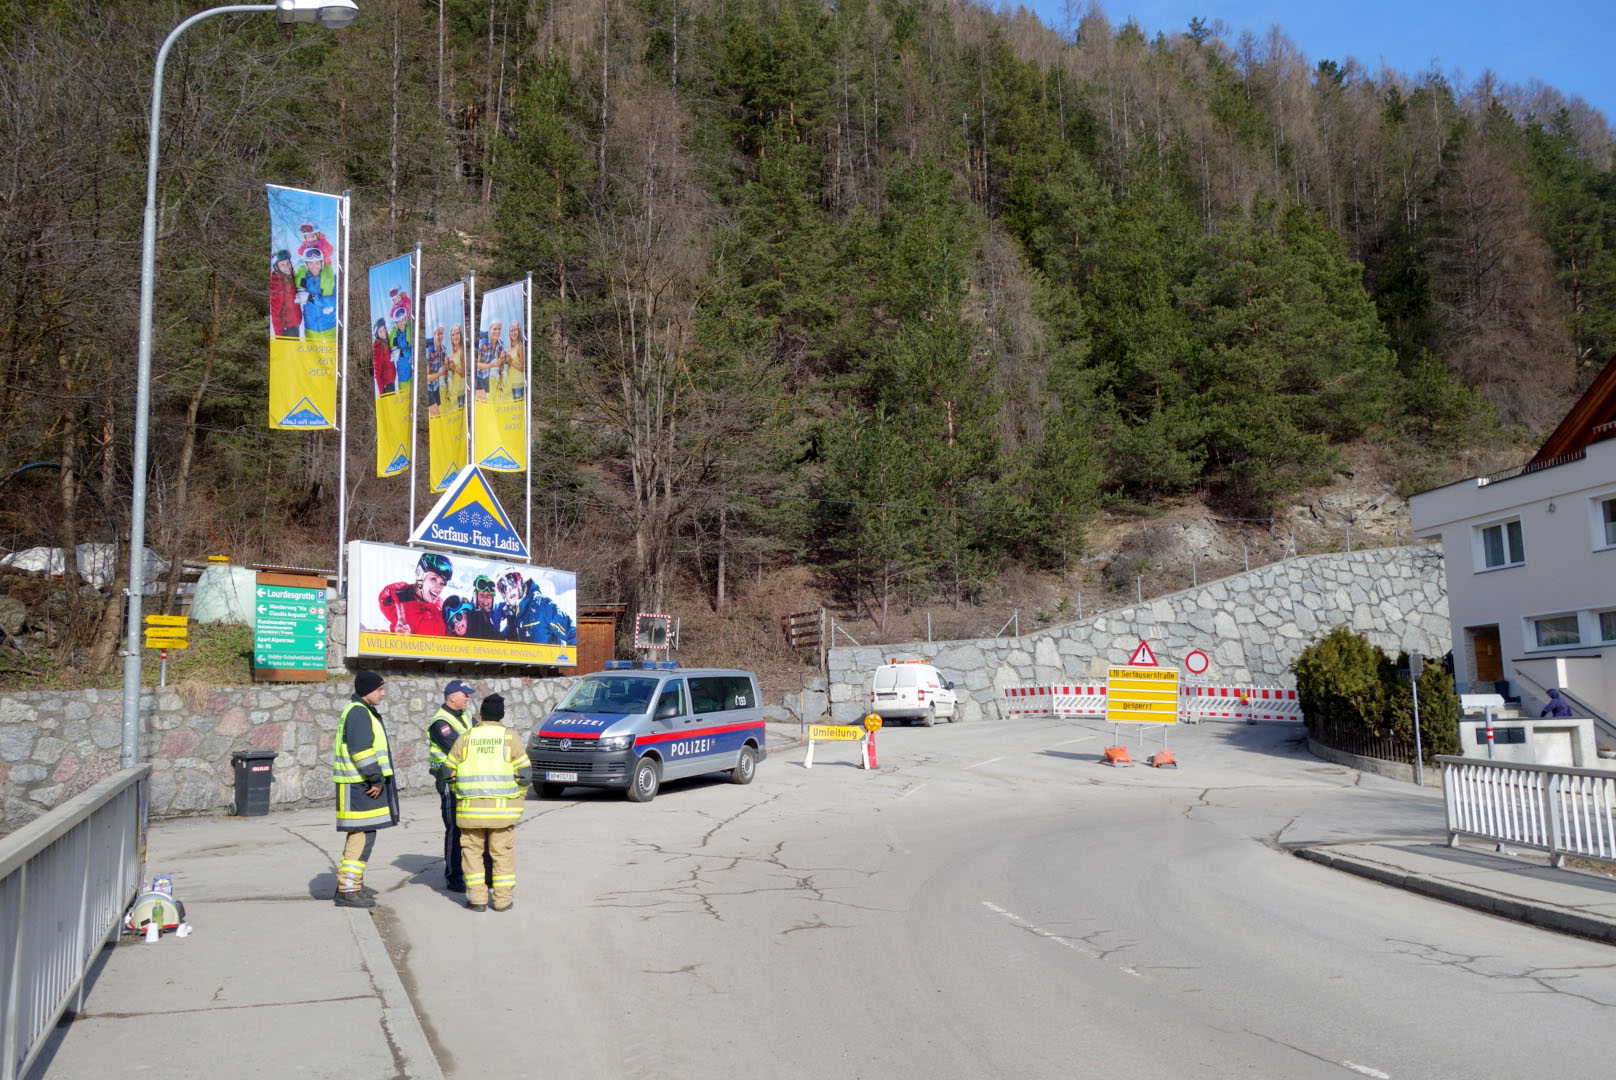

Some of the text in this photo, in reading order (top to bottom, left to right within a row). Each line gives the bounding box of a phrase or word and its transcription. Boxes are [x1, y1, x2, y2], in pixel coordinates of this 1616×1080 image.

[267, 589, 315, 600] Lourdesgrotte
[366, 637, 434, 652] WILLKOMMEN!
[1121, 670, 1175, 680] Serfauserstraße
[1123, 702, 1152, 711] gesperrt
[813, 727, 858, 740] Umleitung
[470, 738, 502, 746] FEUERWEHR
[477, 746, 495, 754] PRUTZ
[671, 738, 710, 757] POLIZEI
